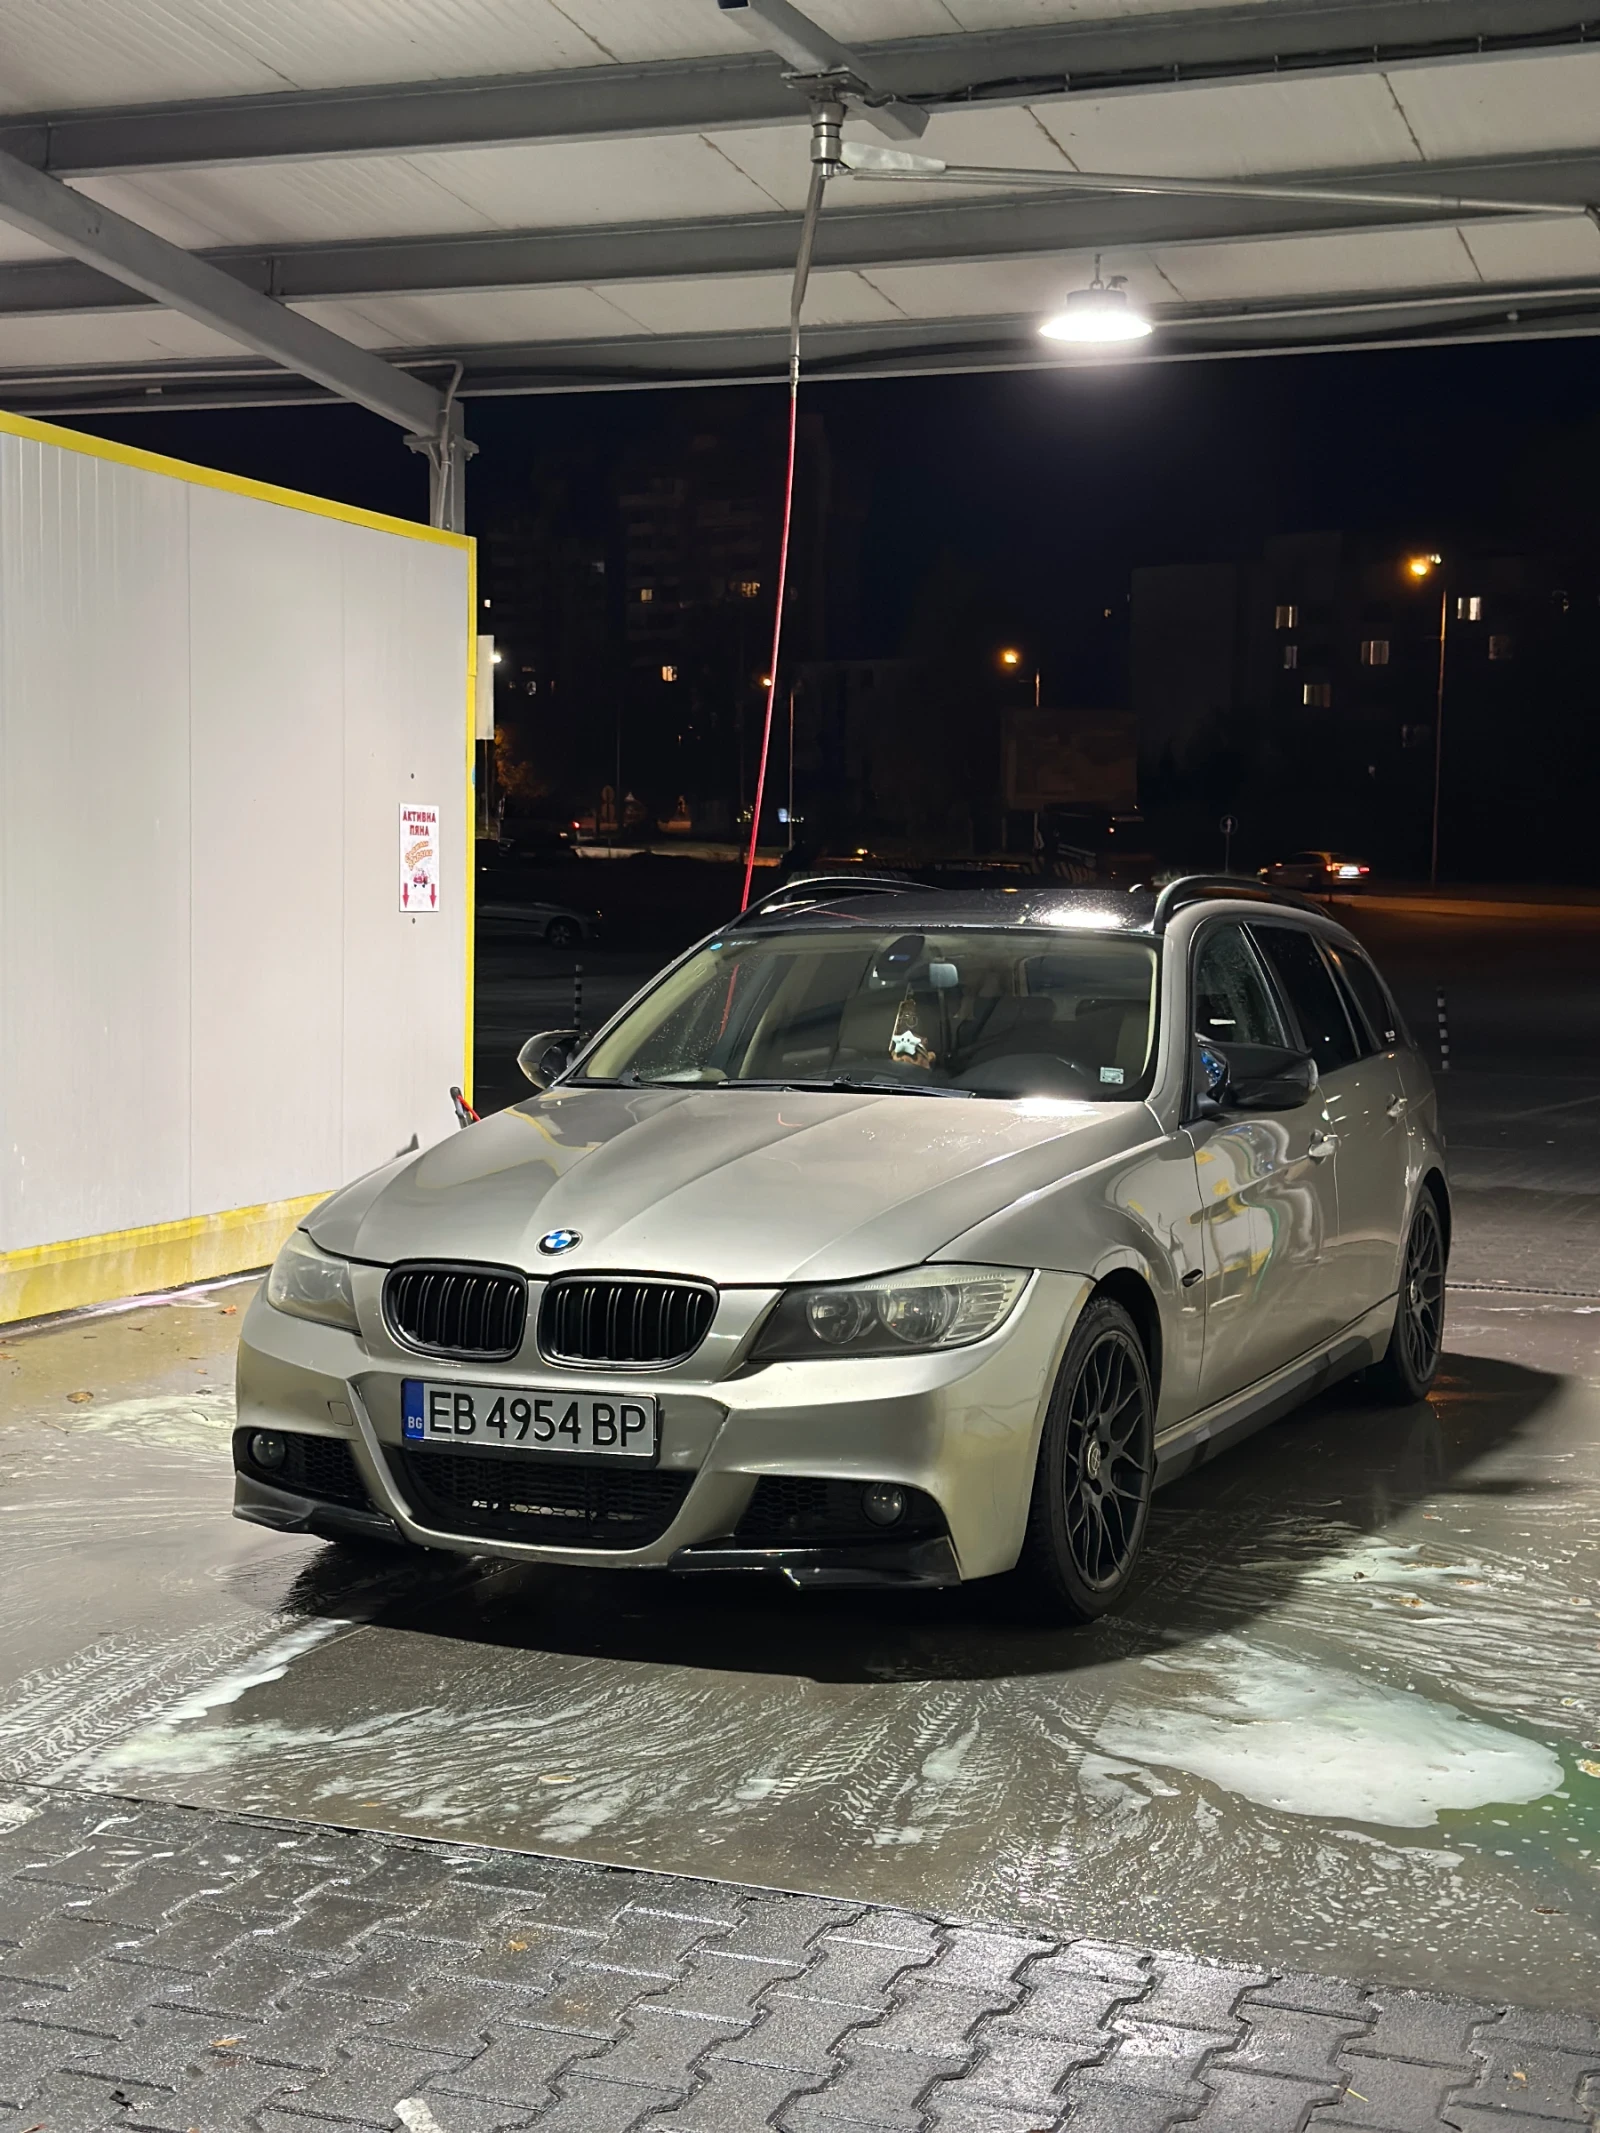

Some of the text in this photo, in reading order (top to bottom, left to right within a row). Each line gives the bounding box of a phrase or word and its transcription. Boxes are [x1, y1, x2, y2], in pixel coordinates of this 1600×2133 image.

[403, 811, 436, 823] АКТИВНА
[409, 825, 429, 836] ПЯНА
[408, 1416, 422, 1429] BG
[430, 1391, 646, 1446] EB 4954 BP
